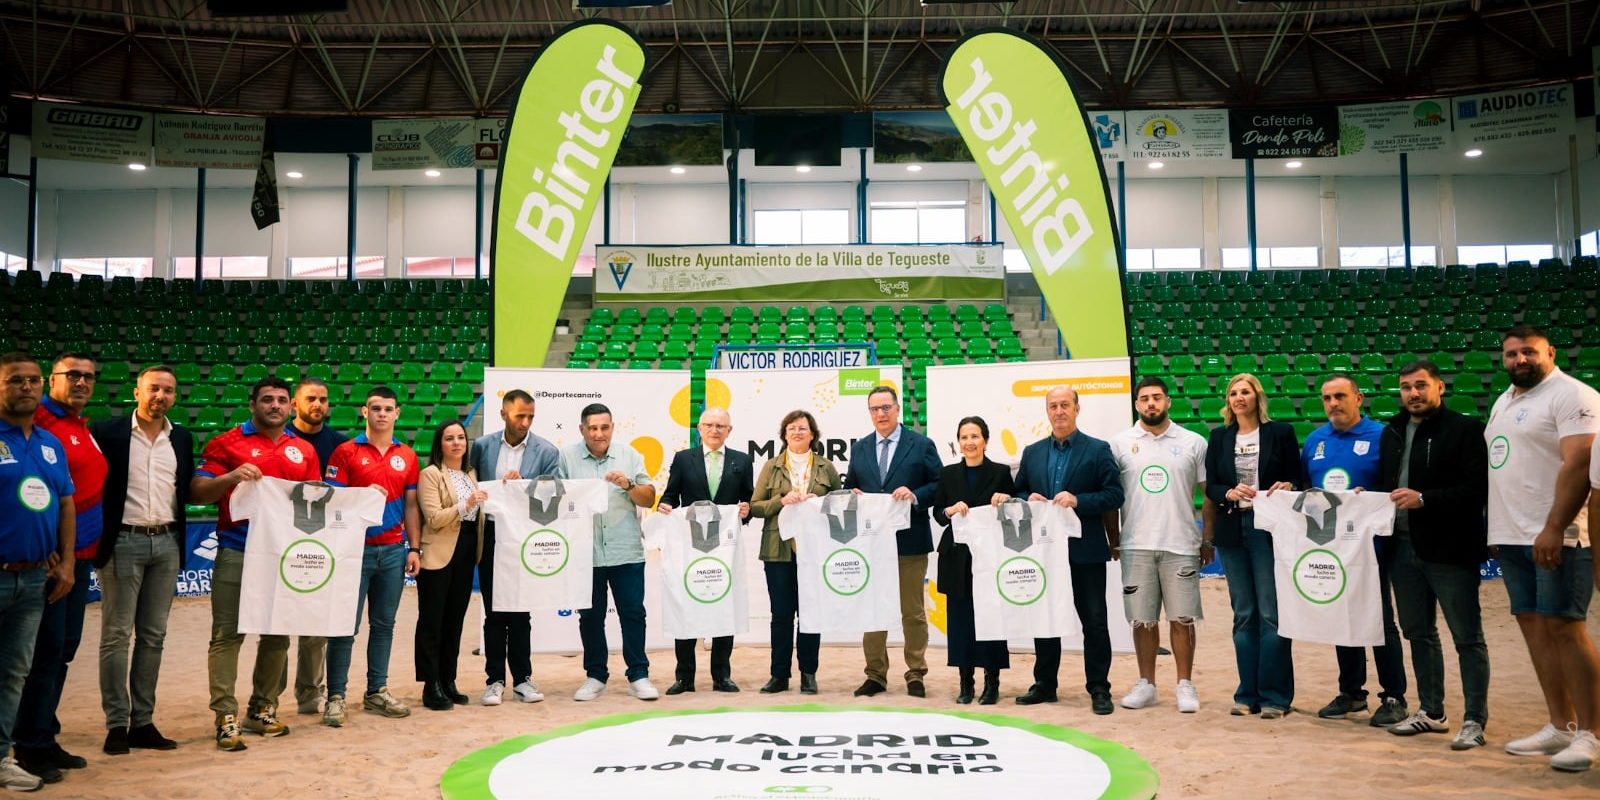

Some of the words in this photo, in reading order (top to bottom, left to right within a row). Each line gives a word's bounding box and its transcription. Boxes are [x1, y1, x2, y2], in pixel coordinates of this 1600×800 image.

[1480, 87, 1568, 112] AUDIOTEC
[51, 110, 138, 128] GIRBAU
[1252, 114, 1313, 126] Cafetería
[184, 132, 220, 141] GRANJA
[1242, 128, 1290, 146] Donde
[1292, 128, 1326, 144] Poli
[514, 44, 636, 262] Binter
[646, 253, 690, 267] Ilustre
[695, 252, 791, 270] Ayuntamiento
[796, 252, 812, 266] de
[816, 252, 828, 266] la
[833, 252, 862, 266] Villa
[866, 252, 883, 266] de
[888, 252, 950, 269] Tegueste
[728, 352, 776, 369] VICTOR
[783, 351, 861, 368] RODRIGUEZ
[845, 379, 874, 389] Binter
[534, 390, 602, 399] @Deportecanario
[668, 733, 990, 748] MADRID
[762, 749, 910, 760] lucha
[931, 753, 997, 761] en
[593, 758, 760, 773] modo
[780, 762, 1004, 774] canario
